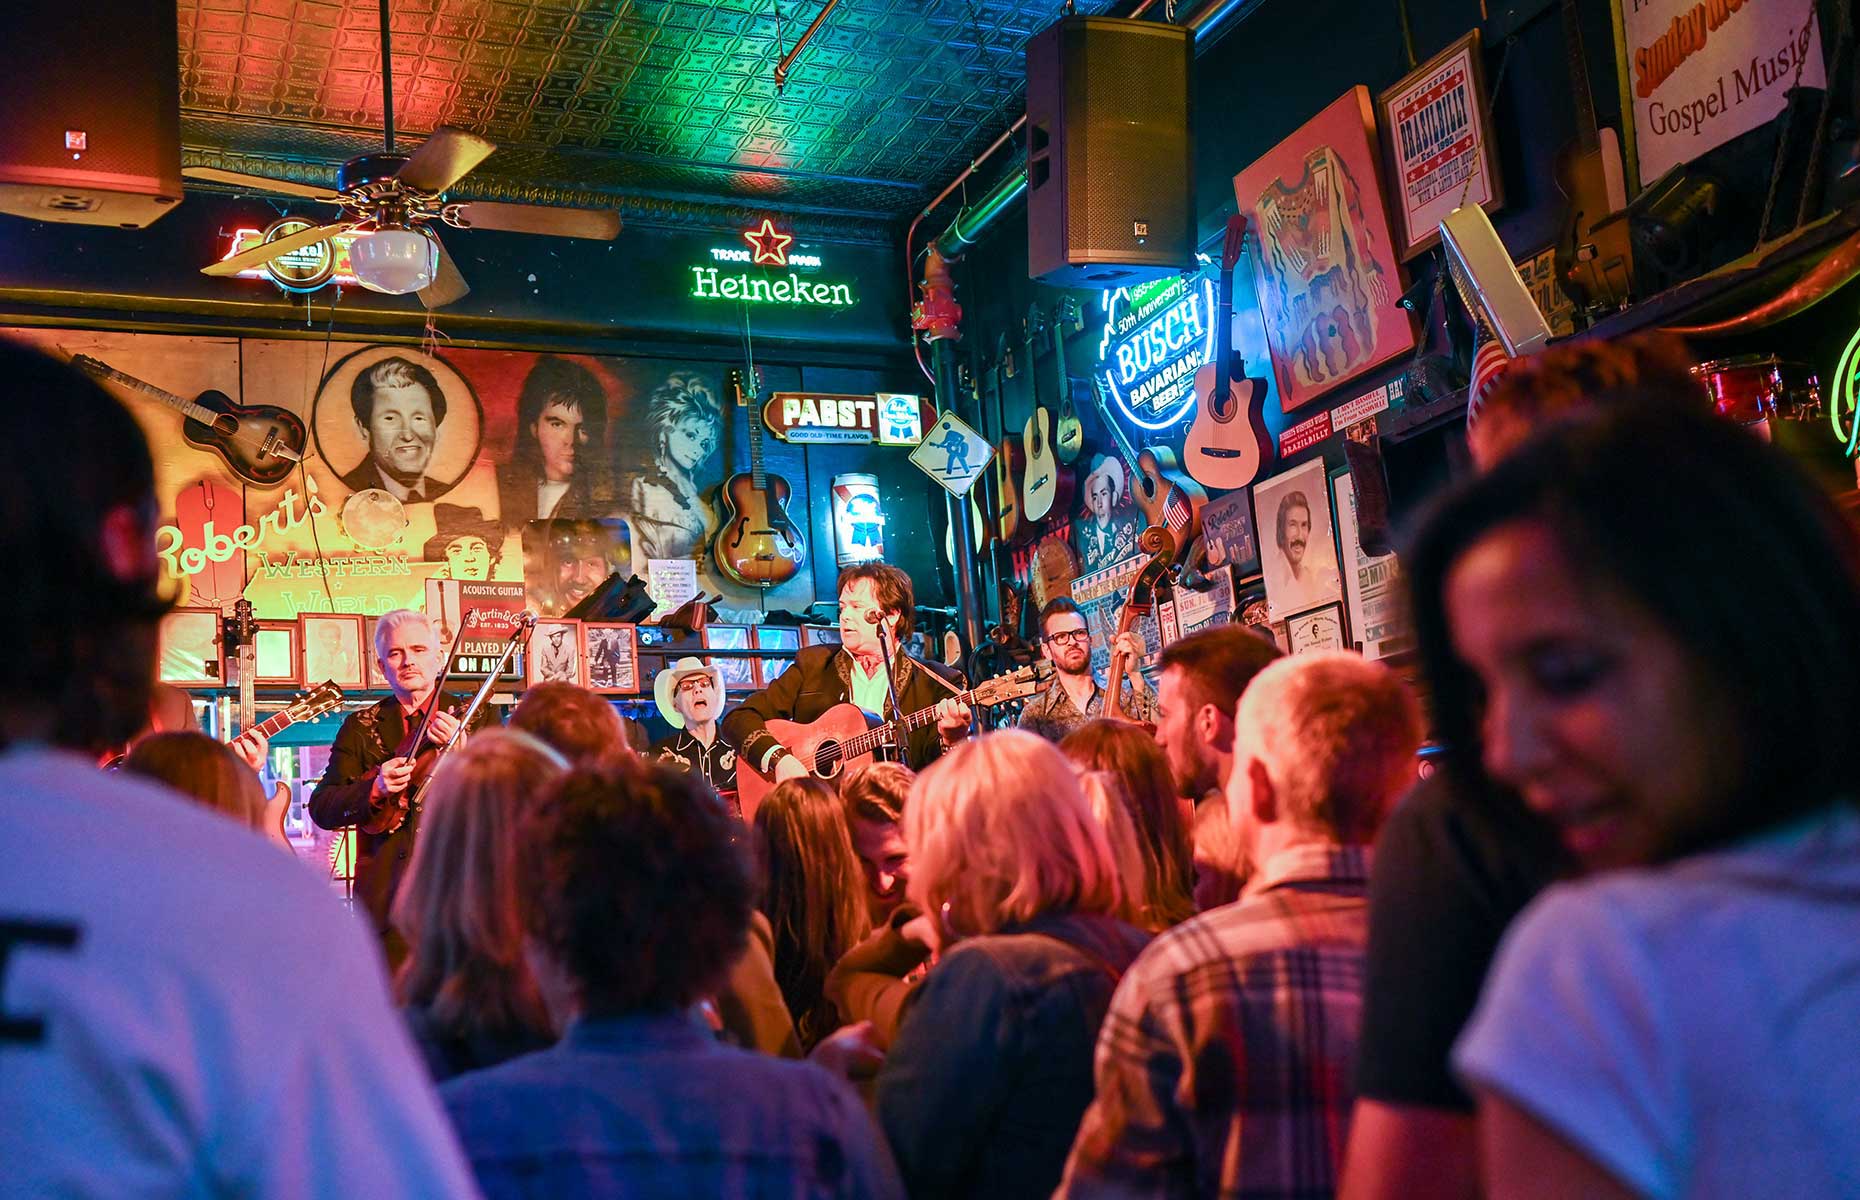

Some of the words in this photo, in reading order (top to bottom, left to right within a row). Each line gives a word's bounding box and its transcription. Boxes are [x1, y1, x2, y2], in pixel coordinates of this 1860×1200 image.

[1635, 3, 1707, 98] Sunday
[1649, 76, 1728, 136] Gospel
[710, 249, 750, 262] TRADE
[789, 254, 822, 267] MARK
[692, 266, 853, 305] Heineken
[1118, 312, 1137, 335] 50th
[1137, 279, 1181, 321] Anniversary
[1116, 293, 1203, 385] BUSCH
[1130, 350, 1199, 406] BAVARIAN
[782, 399, 875, 429] PABST
[1152, 385, 1183, 411] BEER
[155, 474, 328, 579] Robert's
[259, 551, 411, 579] WESTERN
[462, 585, 496, 595] ACOUSTIC
[498, 586, 523, 596] GUITAR
[458, 657, 477, 672] ON
[481, 658, 506, 672] AI
[464, 642, 499, 653] PLAYED
[502, 643, 525, 654] HRE
